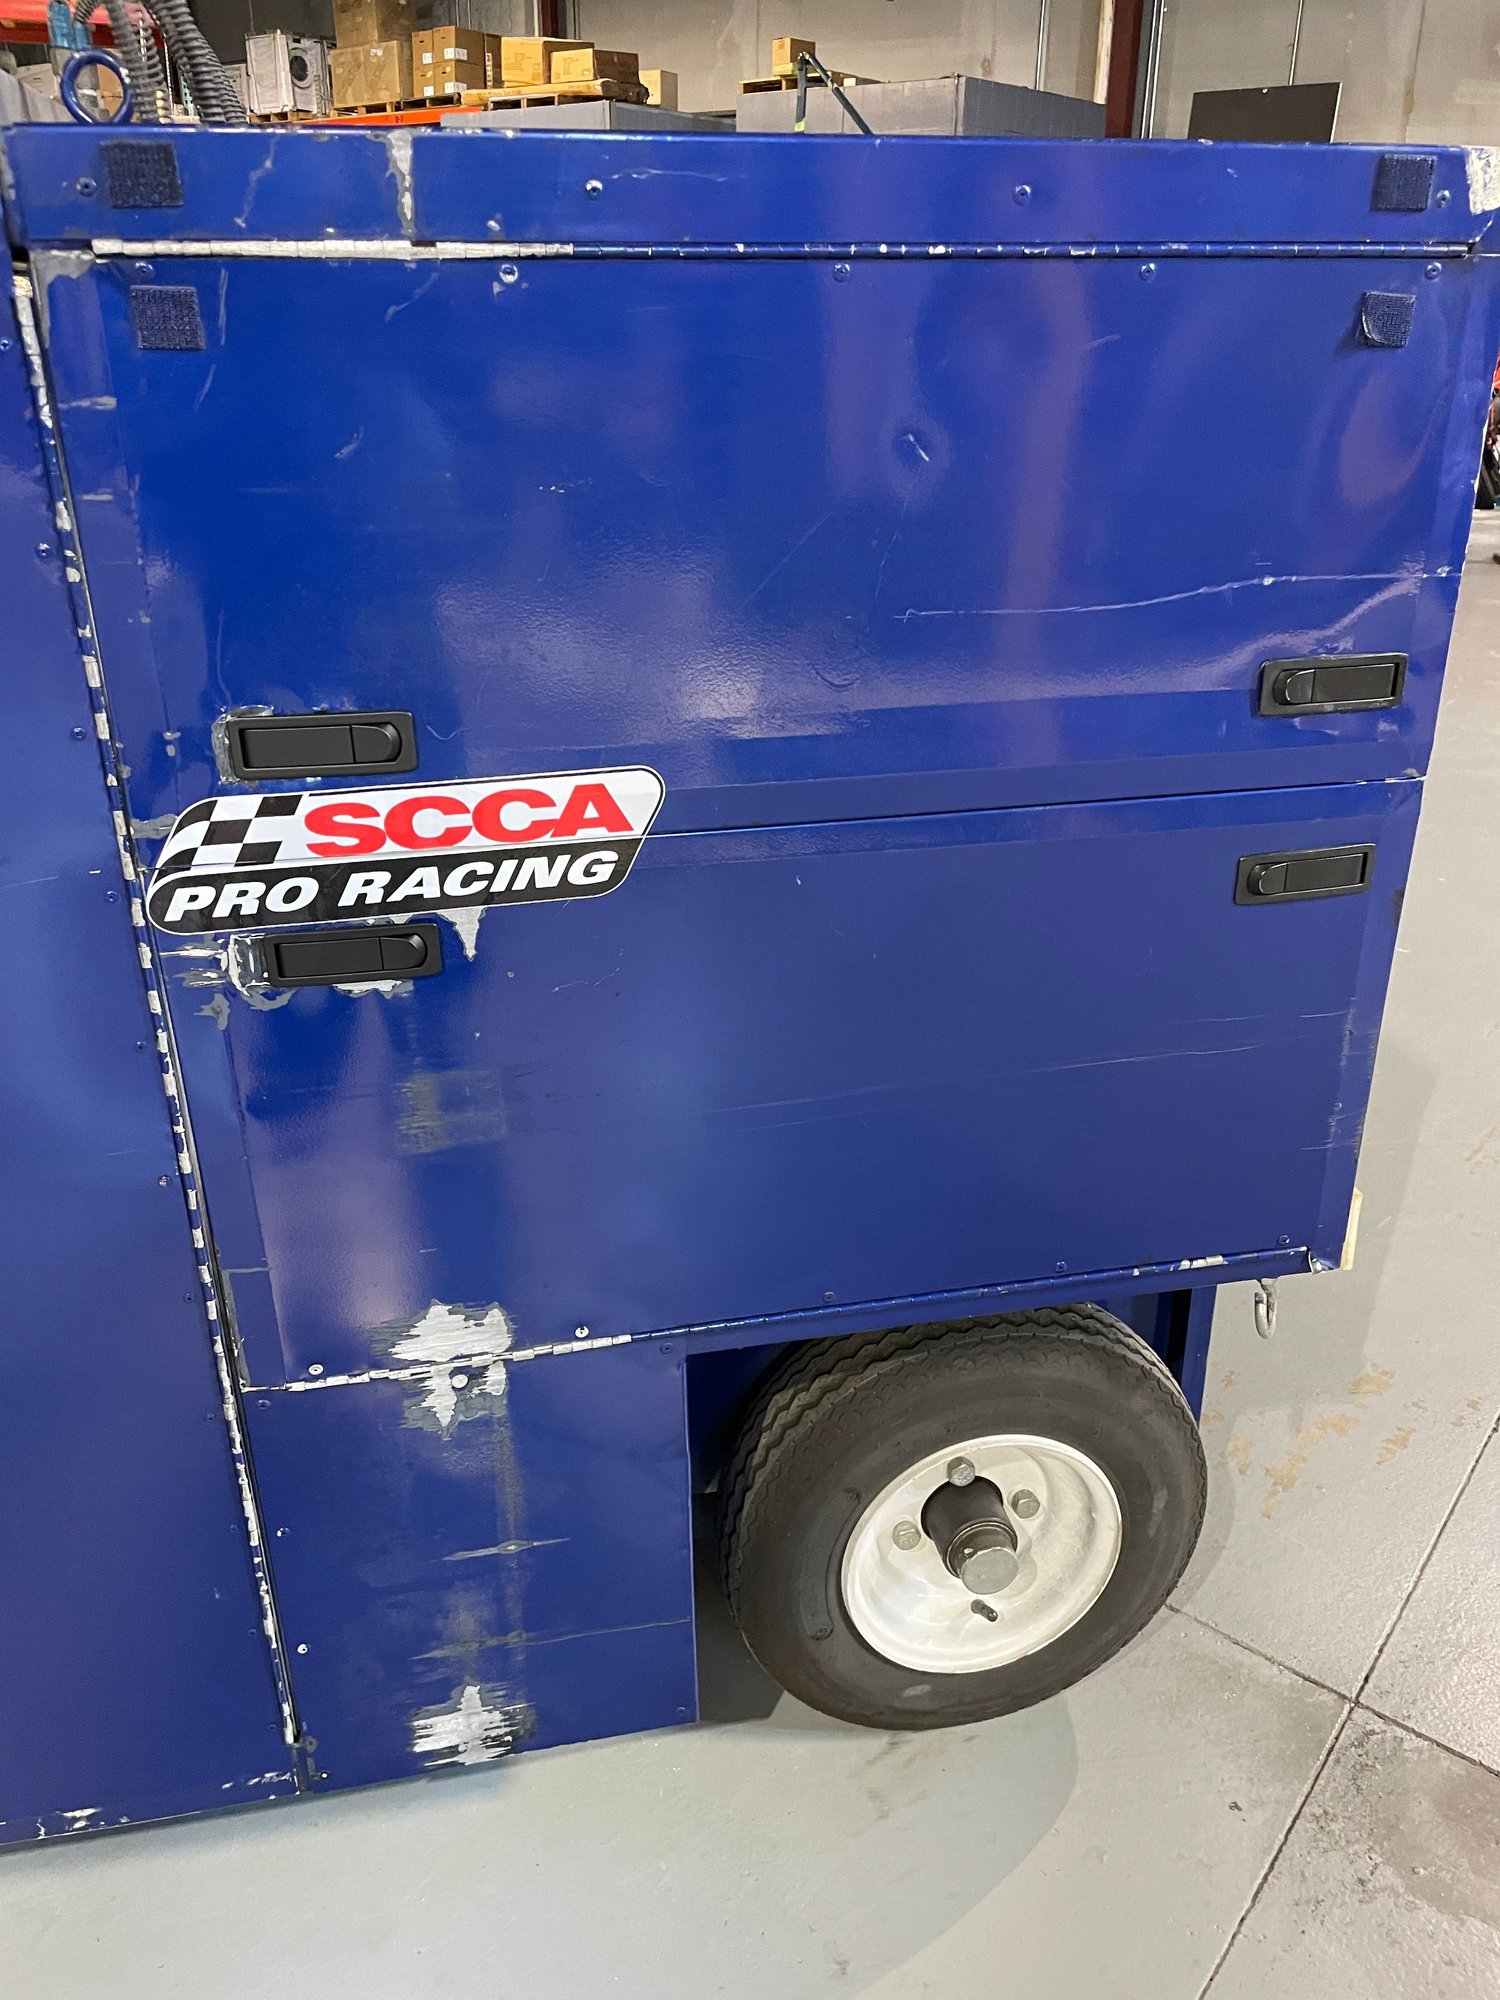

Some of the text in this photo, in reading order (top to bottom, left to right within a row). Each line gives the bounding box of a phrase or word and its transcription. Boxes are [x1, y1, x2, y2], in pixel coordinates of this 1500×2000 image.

[305, 783, 634, 858] SCCA
[164, 851, 619, 922] PRO RACING
